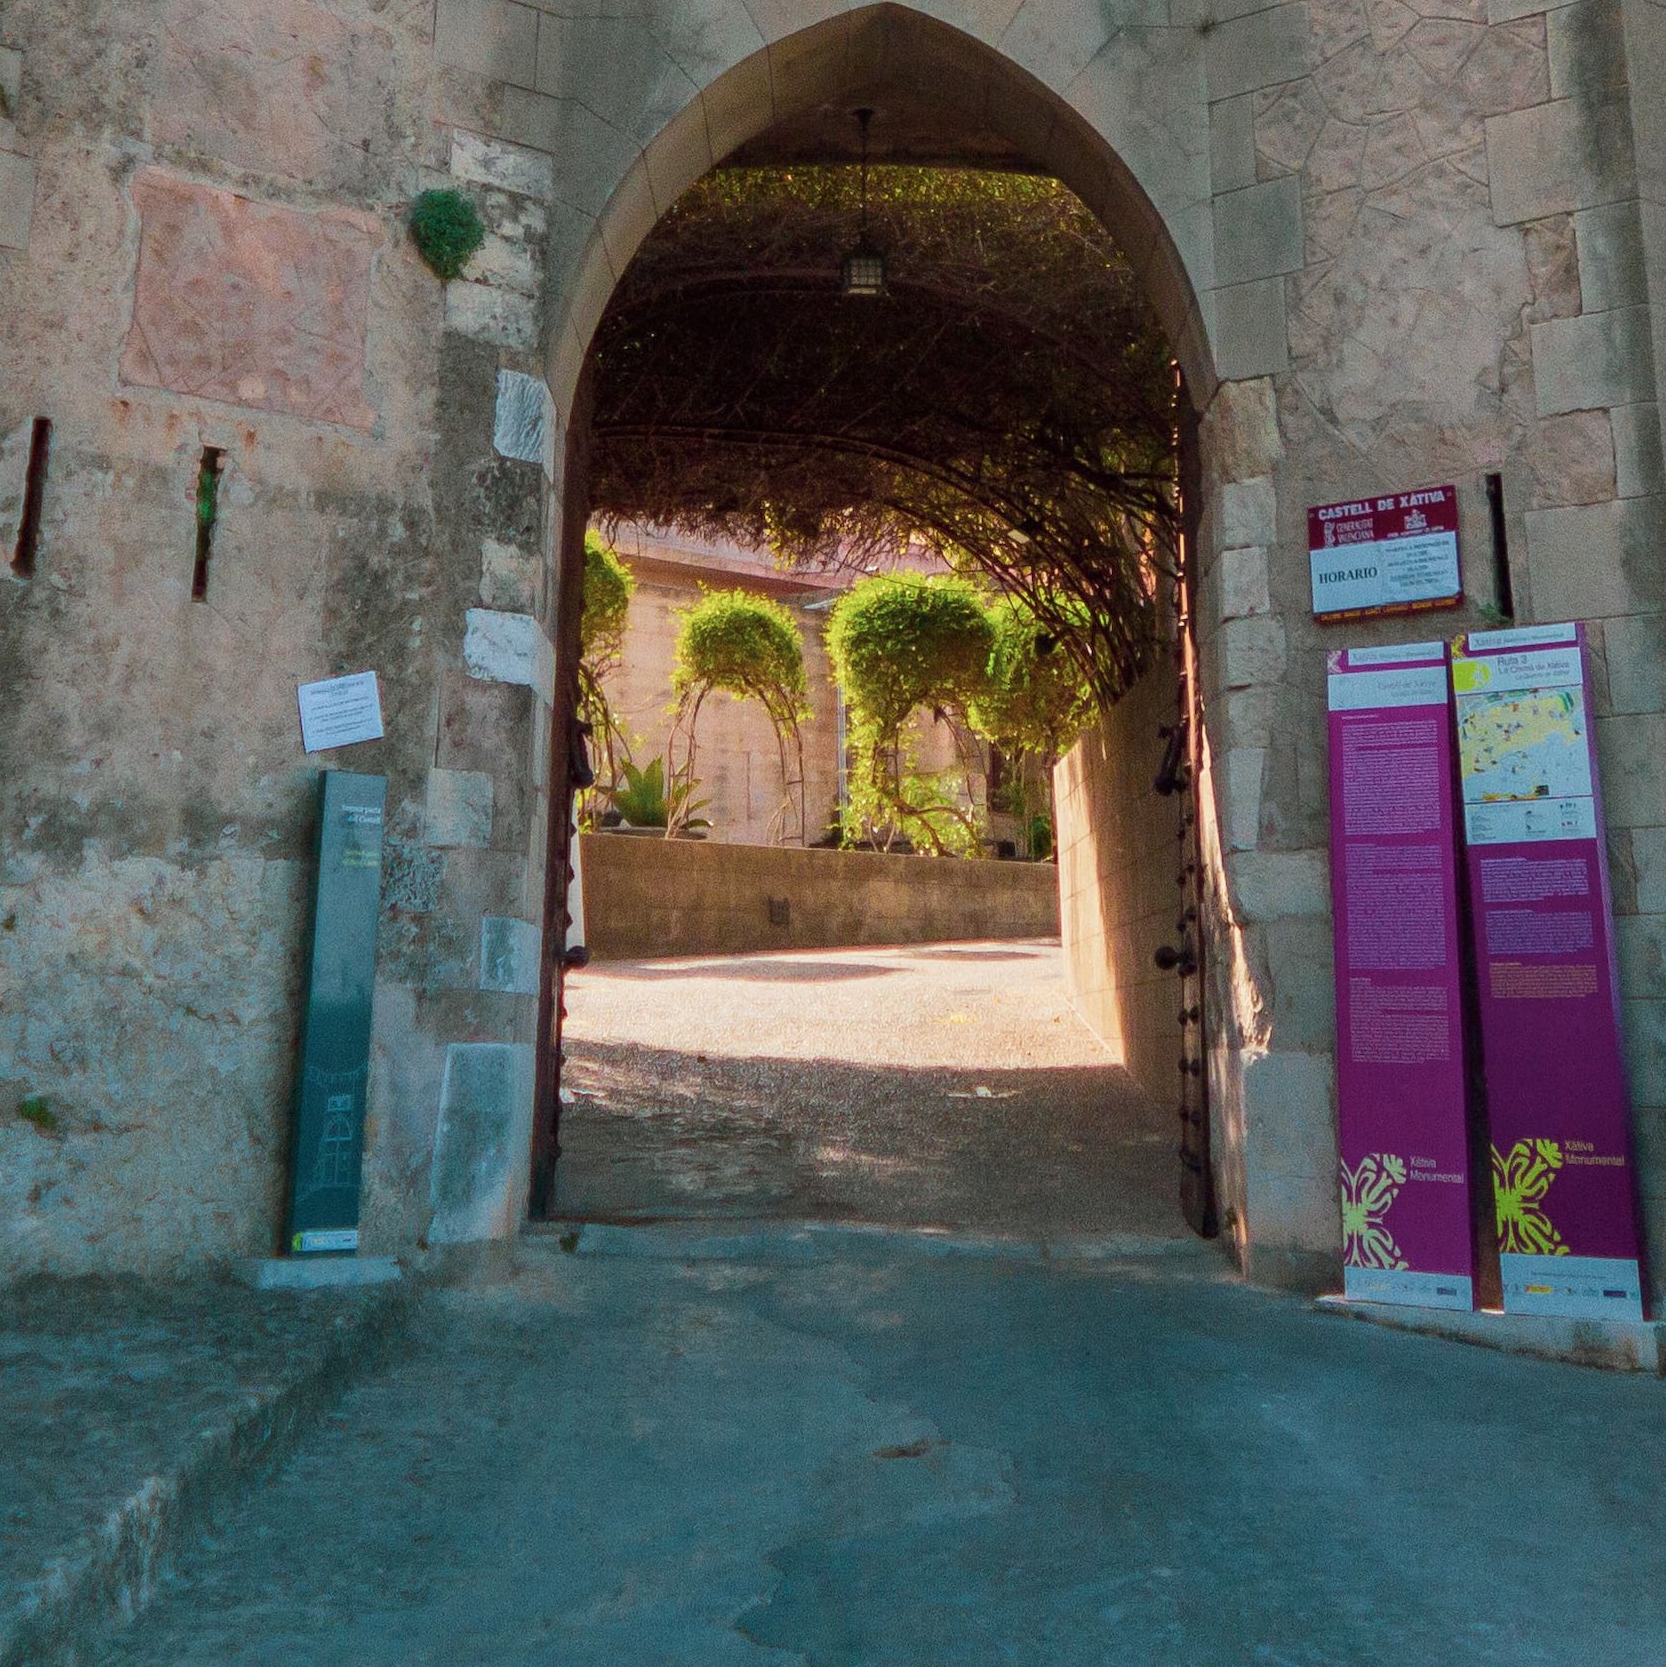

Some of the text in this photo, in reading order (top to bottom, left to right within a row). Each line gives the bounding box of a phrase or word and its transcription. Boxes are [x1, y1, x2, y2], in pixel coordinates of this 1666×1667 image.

[1318, 502, 1374, 521] CASTELL
[1378, 498, 1395, 511] DE
[1319, 567, 1378, 584] HORARIO
[1565, 1153, 1625, 1167] Monumental
[1410, 1169, 1465, 1185] Monumental
